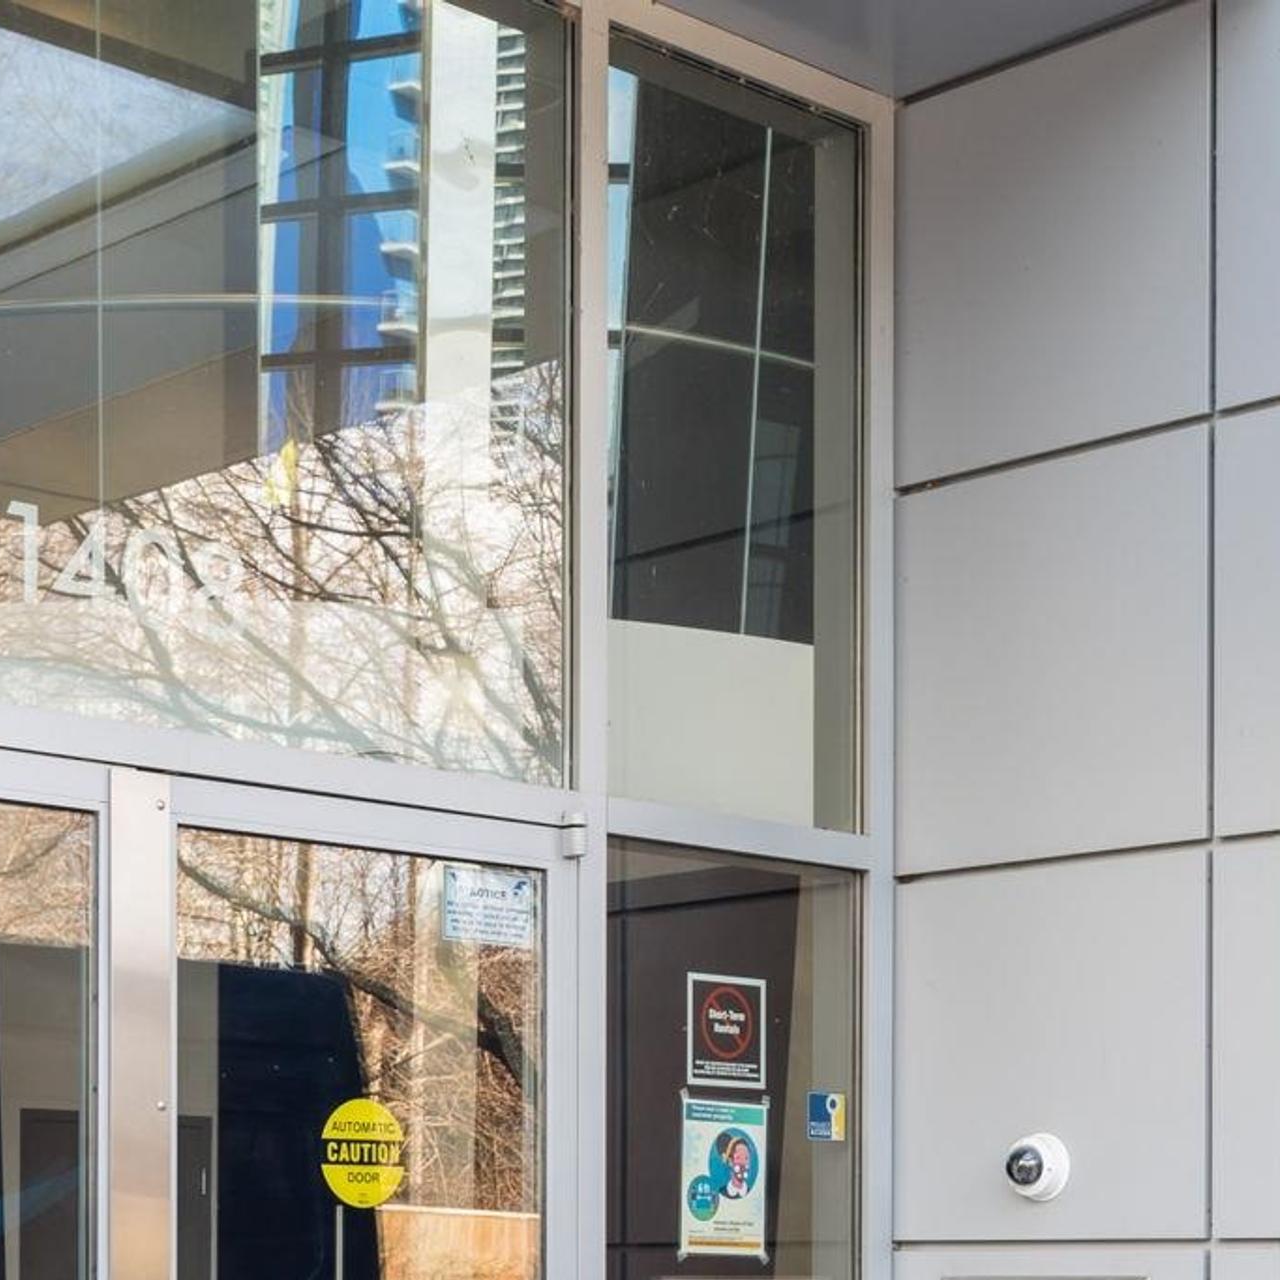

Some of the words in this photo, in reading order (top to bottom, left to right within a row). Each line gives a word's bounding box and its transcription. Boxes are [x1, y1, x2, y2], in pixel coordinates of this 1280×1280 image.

[332, 1121, 397, 1134] AUTOMATIC
[327, 1141, 400, 1164] CAUTION
[347, 1171, 381, 1184] DOOR
